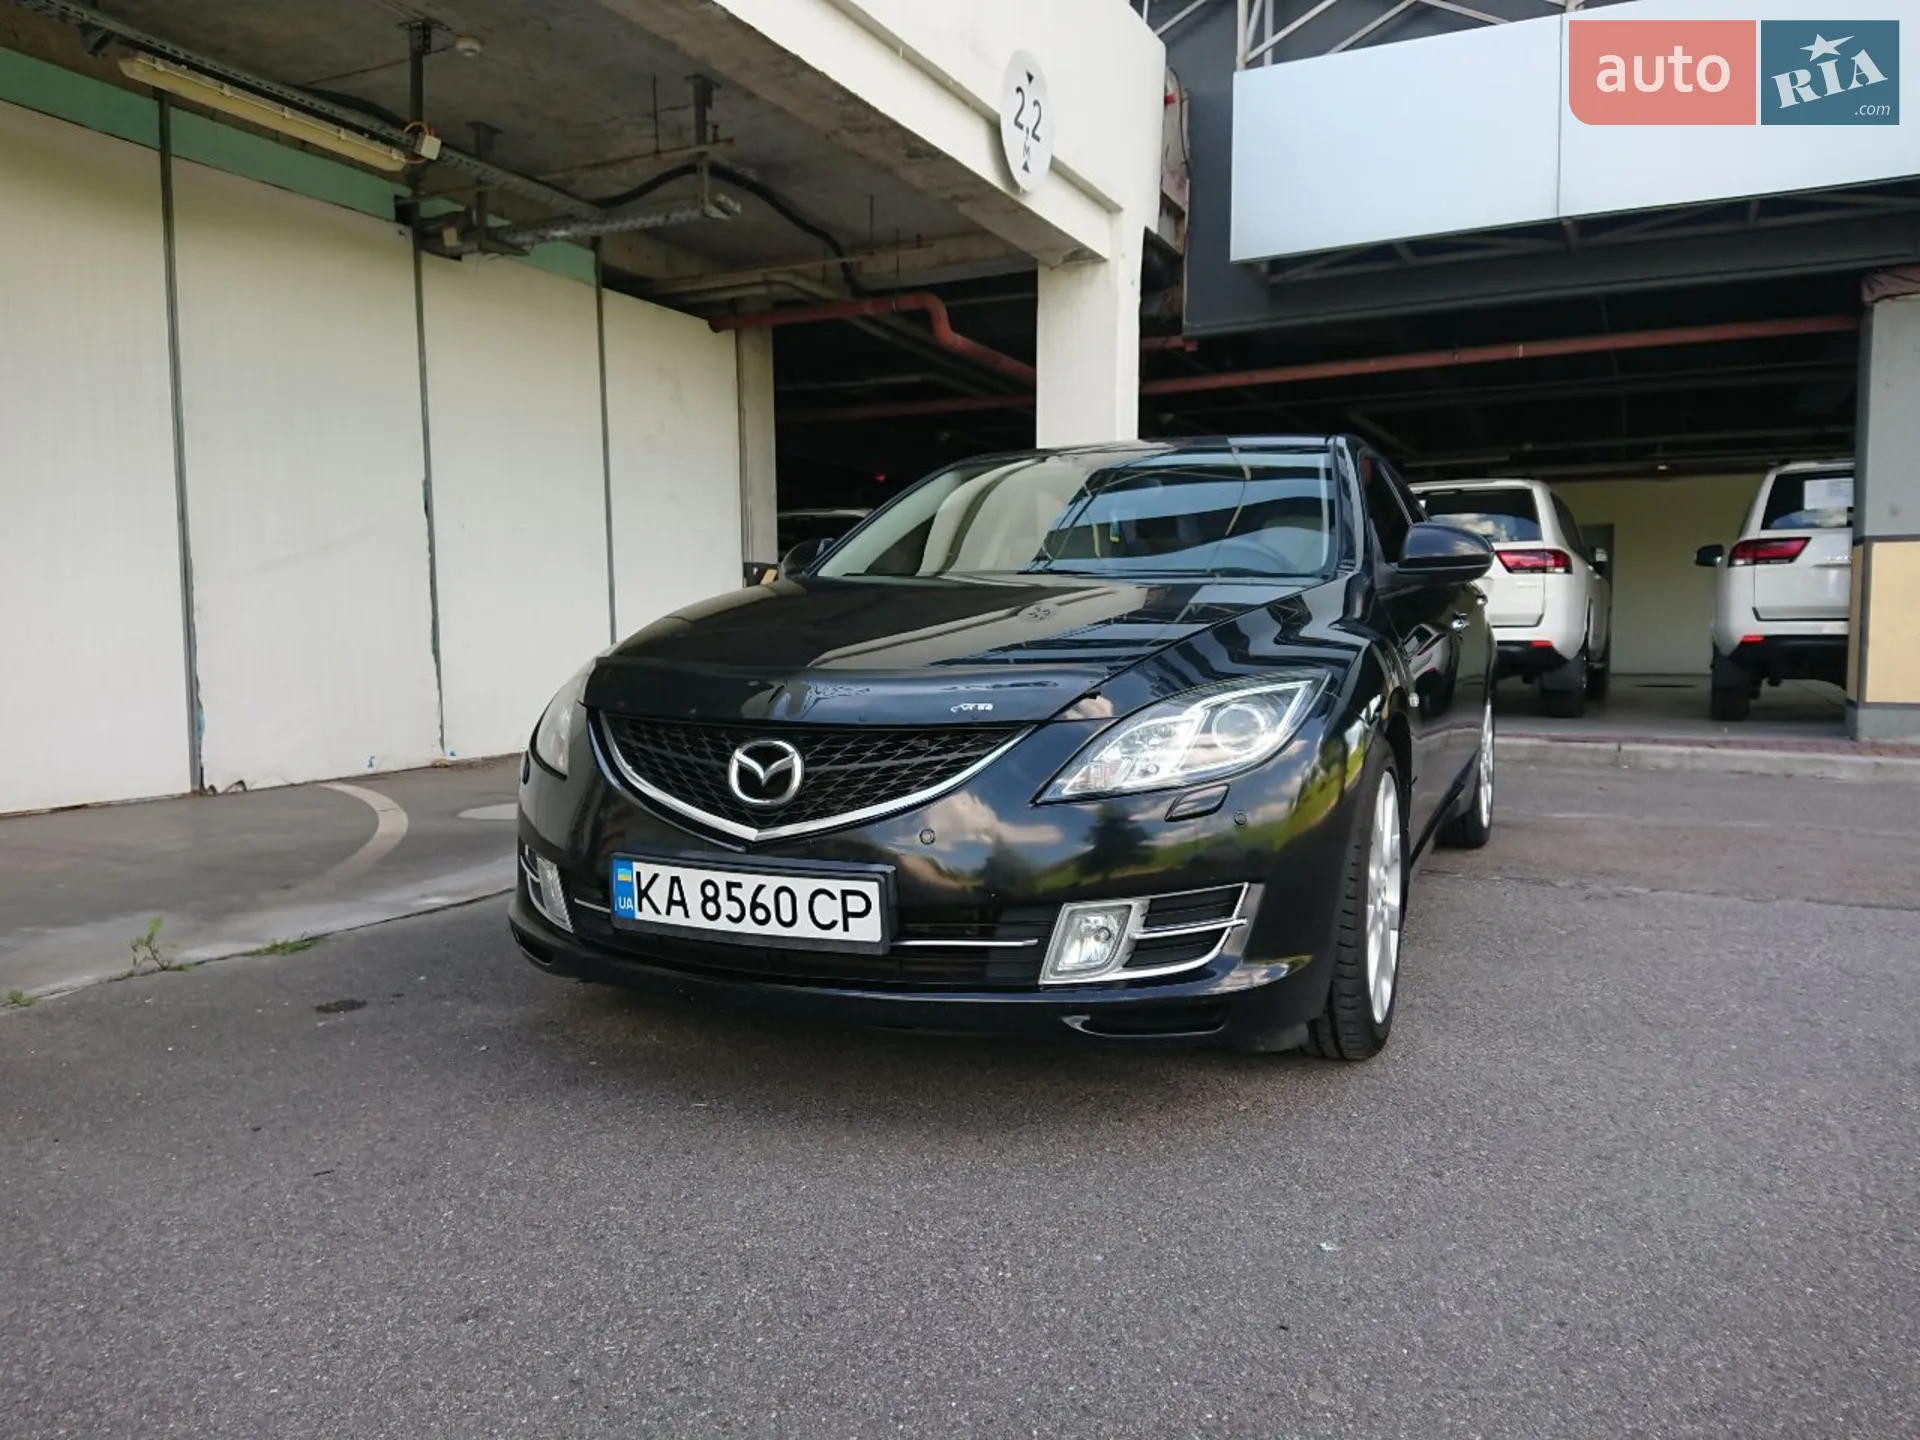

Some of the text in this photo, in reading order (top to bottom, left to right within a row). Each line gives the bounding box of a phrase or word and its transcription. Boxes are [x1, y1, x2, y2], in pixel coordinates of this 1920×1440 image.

[618, 896, 634, 911] UA
[635, 871, 872, 932] KA 8560 CP
